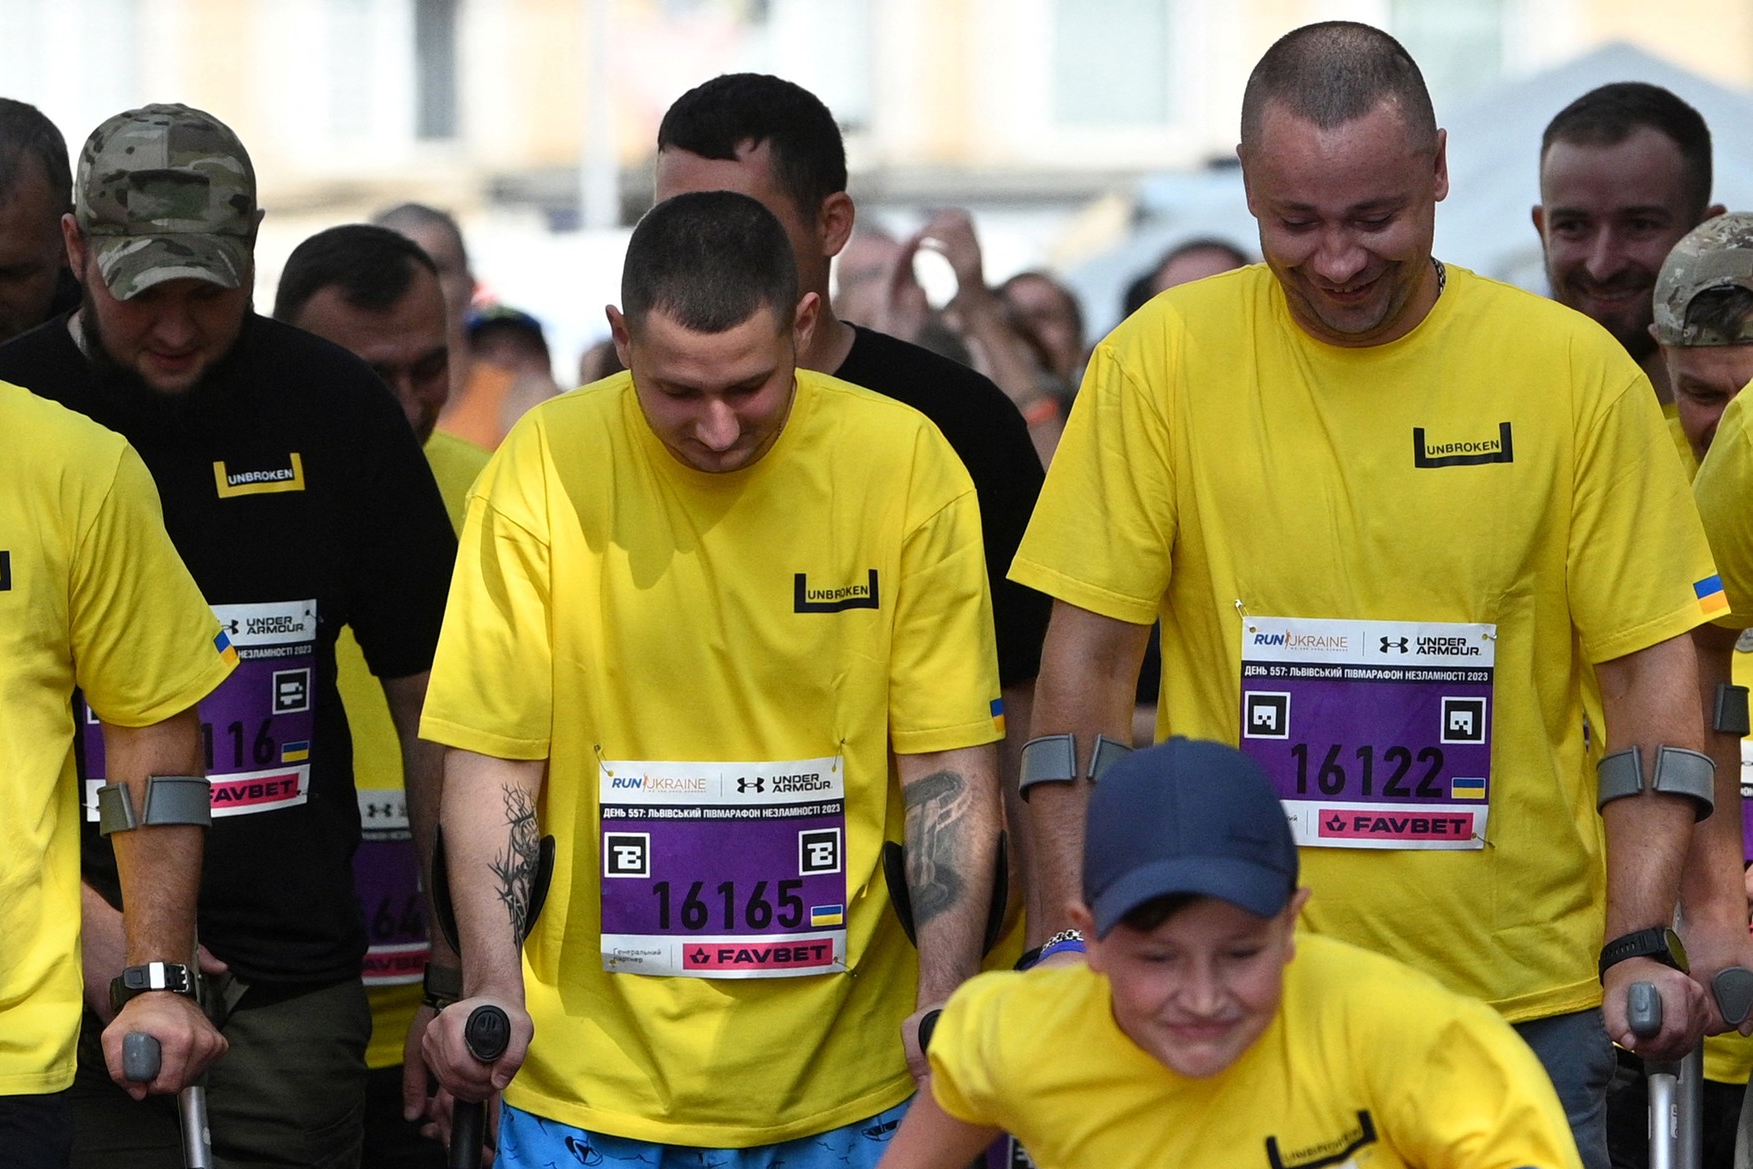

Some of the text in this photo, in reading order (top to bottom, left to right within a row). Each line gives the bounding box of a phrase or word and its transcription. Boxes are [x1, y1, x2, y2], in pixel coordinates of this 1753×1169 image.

[1426, 439, 1501, 455] UNBROKEN
[227, 468, 294, 486] UNBROKEN
[807, 585, 869, 600] UNBROKEN
[245, 616, 293, 626] UNDER
[245, 624, 304, 635] ARMOUR
[1254, 633, 1284, 646] RUN
[1416, 637, 1467, 647] UNDER
[237, 645, 313, 660] НЕЗЛАМНОСТІ 2023
[1416, 645, 1479, 656] ARMOUR
[1244, 664, 1489, 682] ДЕНЬ 557: ЛЬВІВСЬКИЙ ПІВМАРАФОН НЕЗЛАМНОСТІ 2023
[201, 718, 276, 770] 116
[1291, 743, 1444, 798] 16122
[612, 777, 642, 789] RUN
[772, 773, 821, 784] UNDER
[772, 782, 832, 793] ARMOUR
[603, 803, 841, 819] ДЕНЬ 557: ЛЬВІВСЬКИЙ ПІВМАРАФОН НЕЗЛАМНОСТІ 2023
[1353, 816, 1467, 835] FAVBET
[652, 880, 804, 930] 16165
[717, 945, 828, 964] FAVBET
